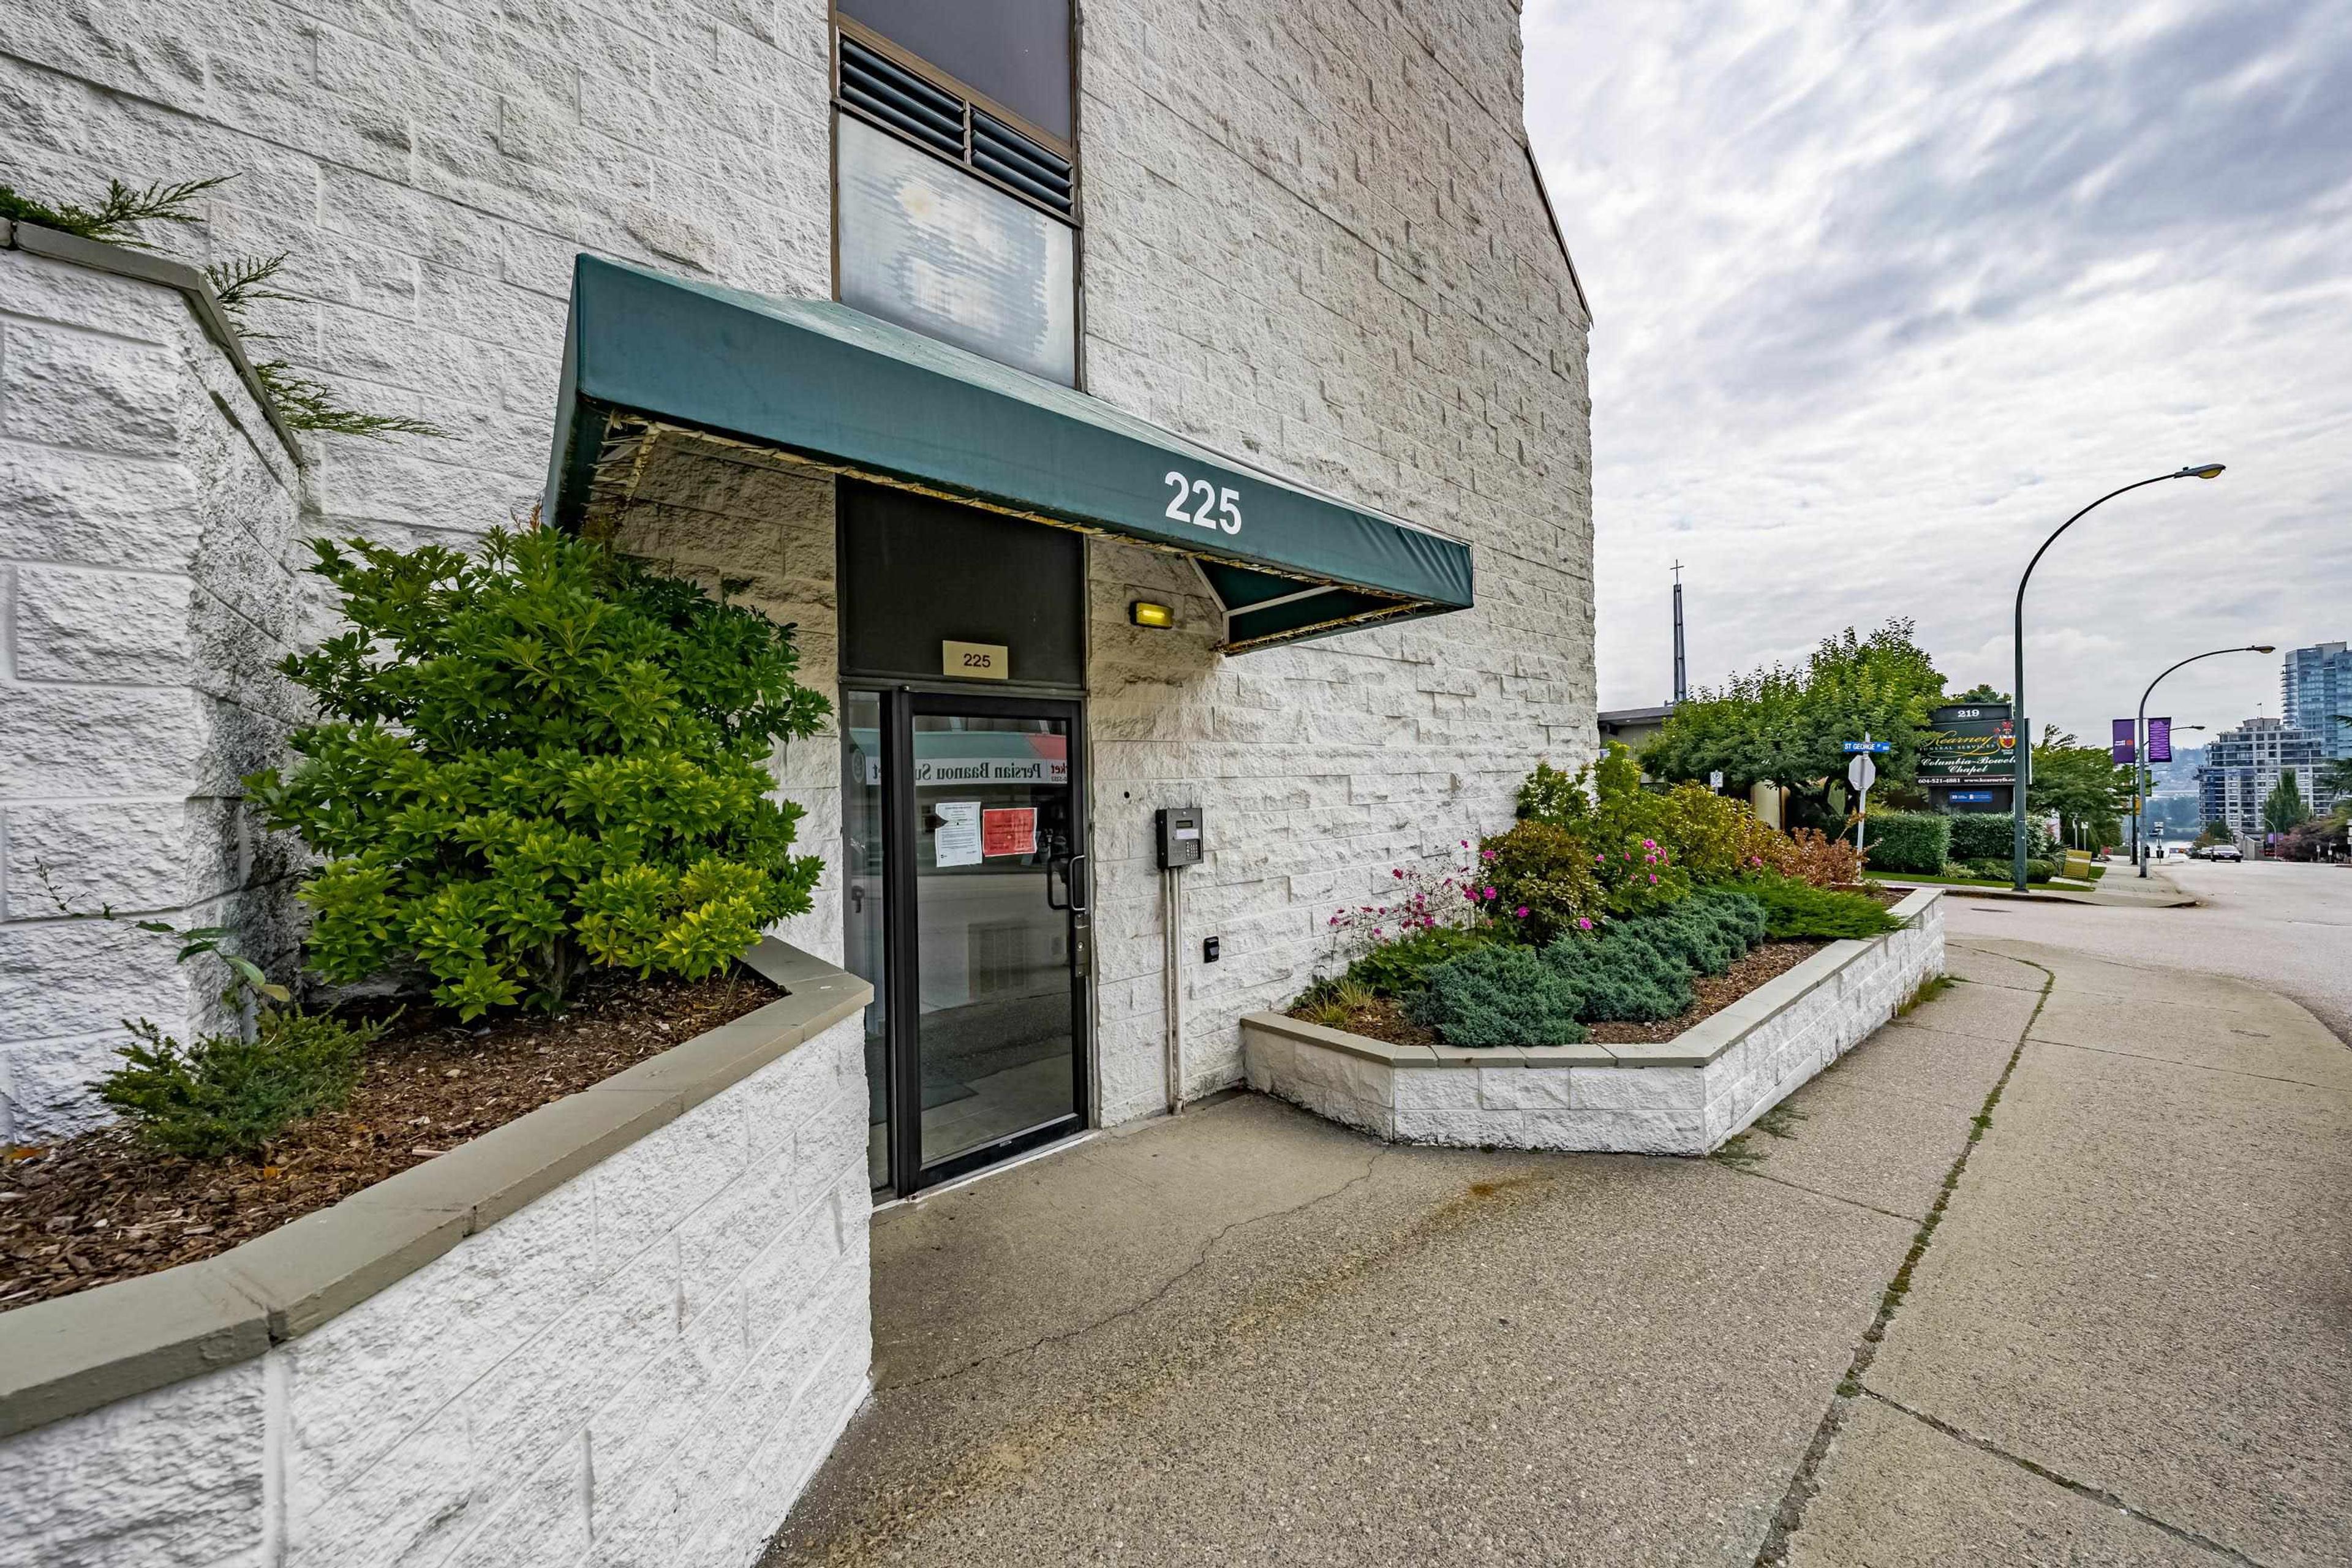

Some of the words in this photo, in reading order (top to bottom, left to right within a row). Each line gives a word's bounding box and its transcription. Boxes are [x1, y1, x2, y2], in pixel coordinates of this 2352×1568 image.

[1165, 471, 1242, 535] 225
[963, 653, 992, 668] 225
[1957, 709, 1980, 717] 219
[1920, 730, 1995, 747] Kearney
[1948, 765, 1988, 775] Chapel
